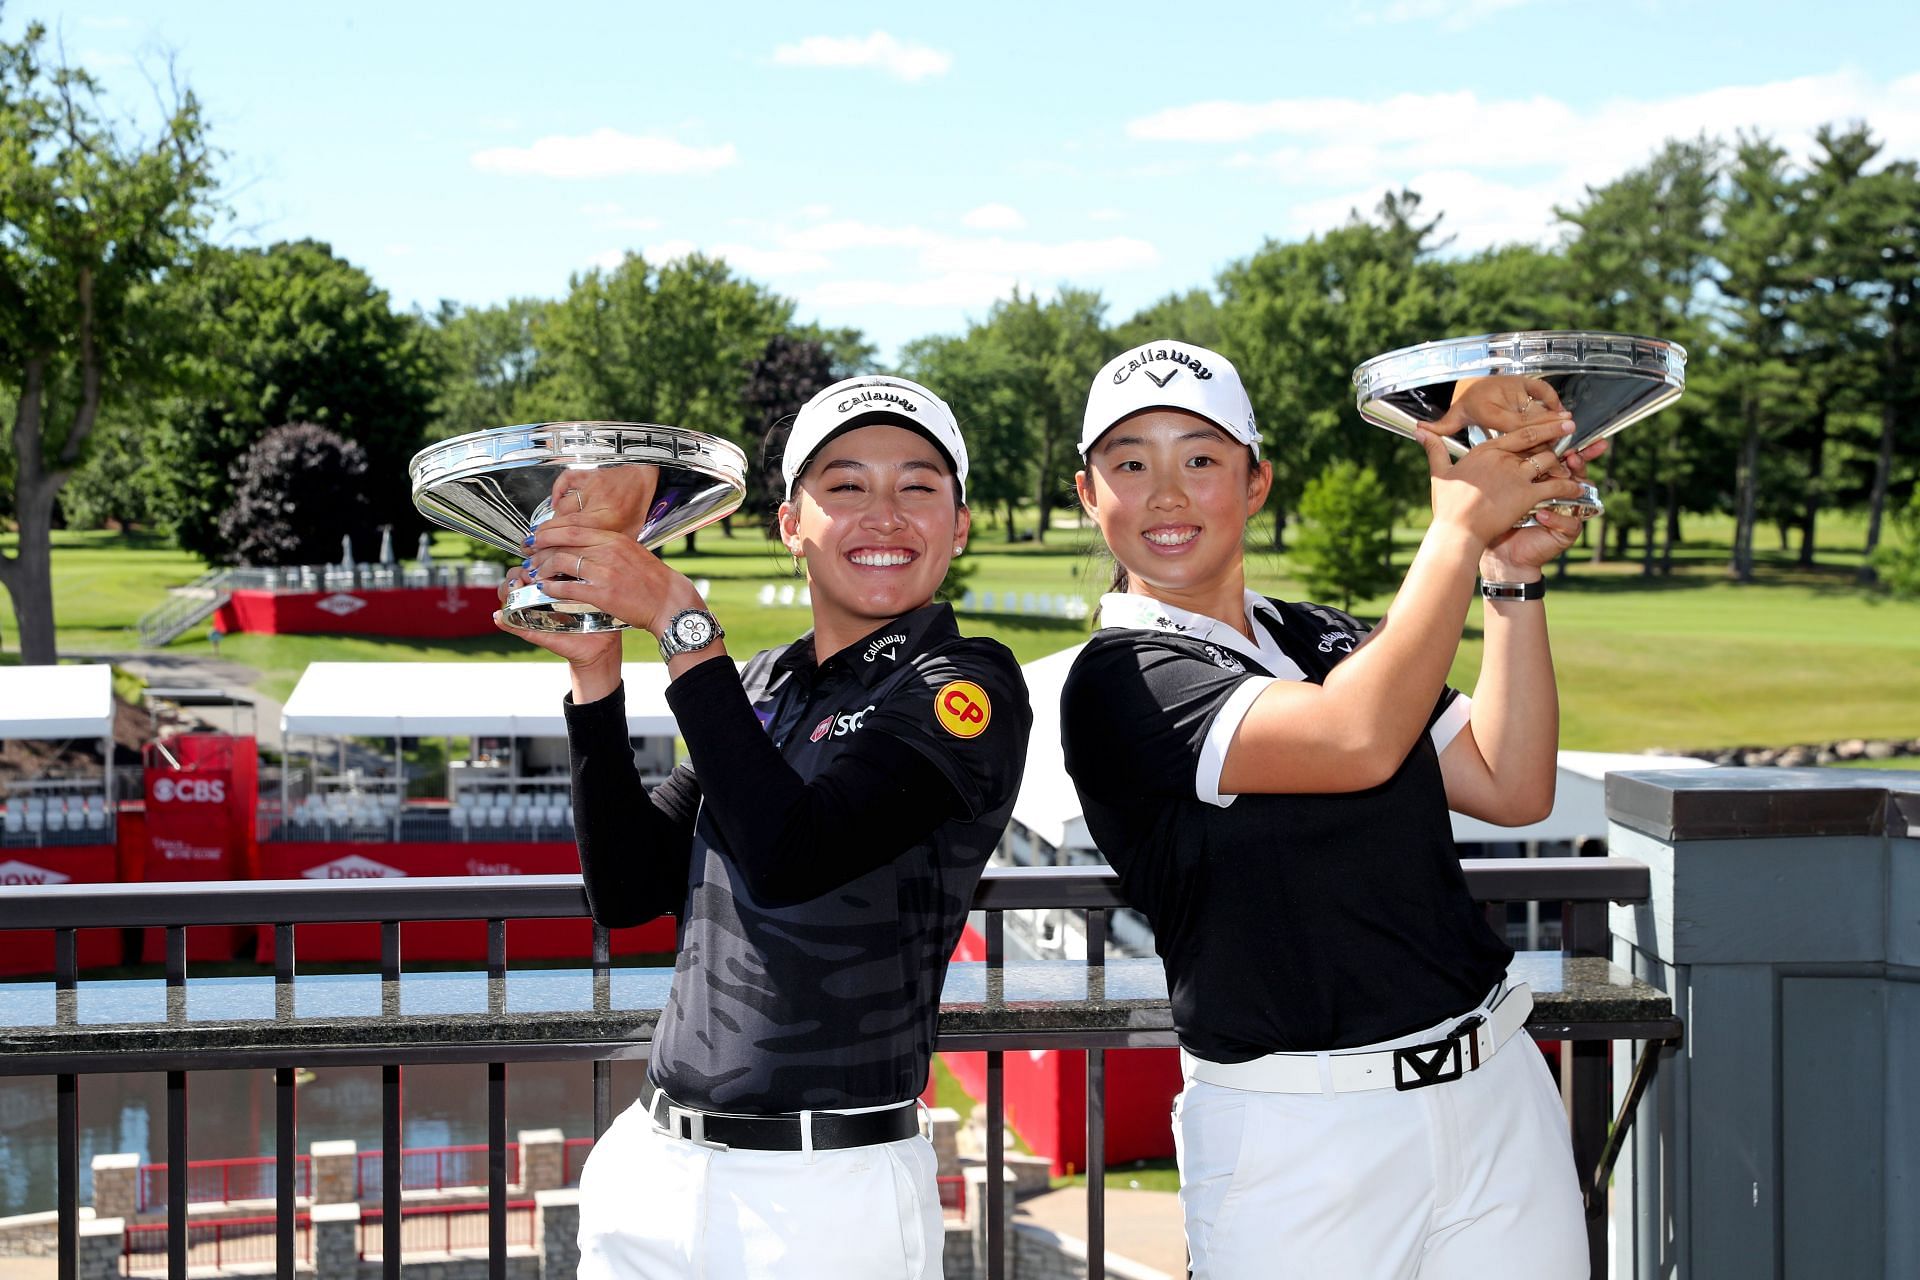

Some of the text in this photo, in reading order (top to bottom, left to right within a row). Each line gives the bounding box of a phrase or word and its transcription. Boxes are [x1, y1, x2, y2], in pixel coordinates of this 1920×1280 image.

[1113, 349, 1213, 385] Callaway
[838, 391, 918, 413] Callaway
[863, 634, 907, 662] Callaway
[1318, 631, 1356, 653] Callaway
[944, 691, 984, 724] CP
[176, 779, 225, 804] CBS
